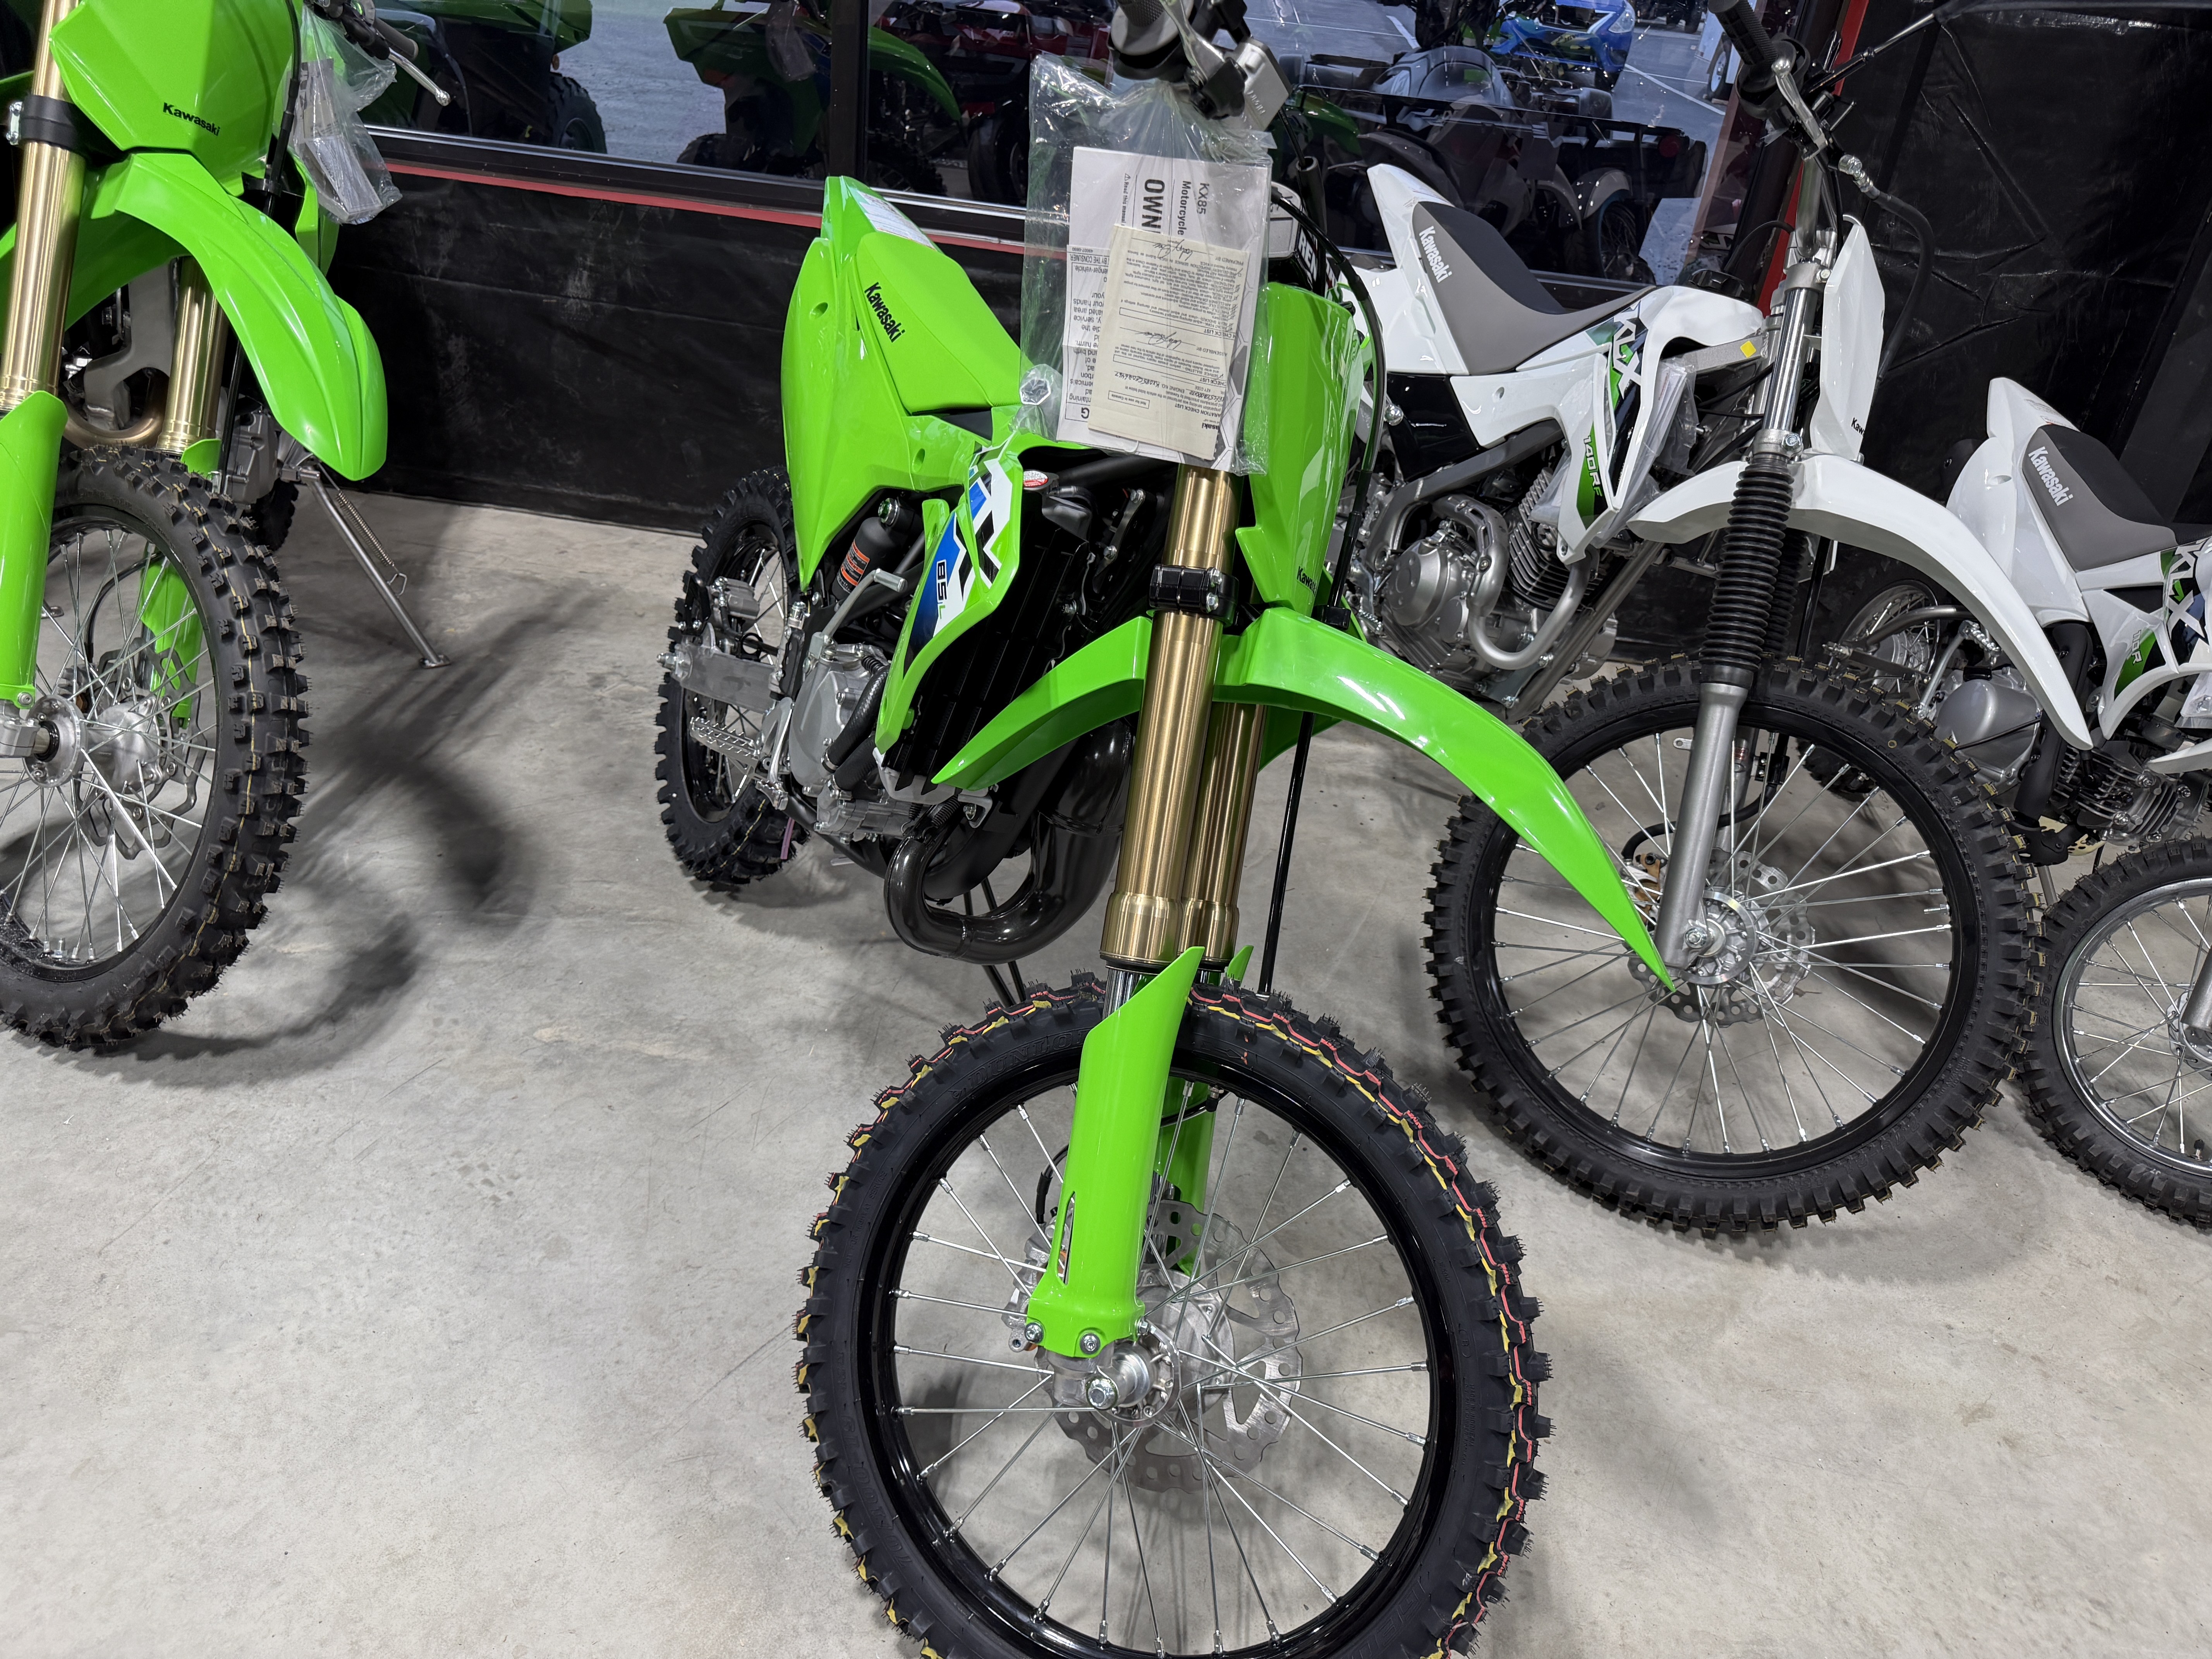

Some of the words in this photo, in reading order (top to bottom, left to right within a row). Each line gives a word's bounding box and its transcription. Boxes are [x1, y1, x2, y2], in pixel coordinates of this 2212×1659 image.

[162, 101, 221, 137] Kawasaki
[1142, 179, 1165, 234] OWN
[1178, 181, 1191, 235] Motorcycle
[1197, 183, 1210, 215] KX85
[1070, 254, 1092, 263] CONSUMER
[1419, 226, 1453, 283] Kawasaki
[864, 282, 905, 343] Kawasaki
[1073, 299, 1091, 307] hands
[1583, 434, 1603, 497] 140RF
[2028, 446, 2074, 507] Kawasaki
